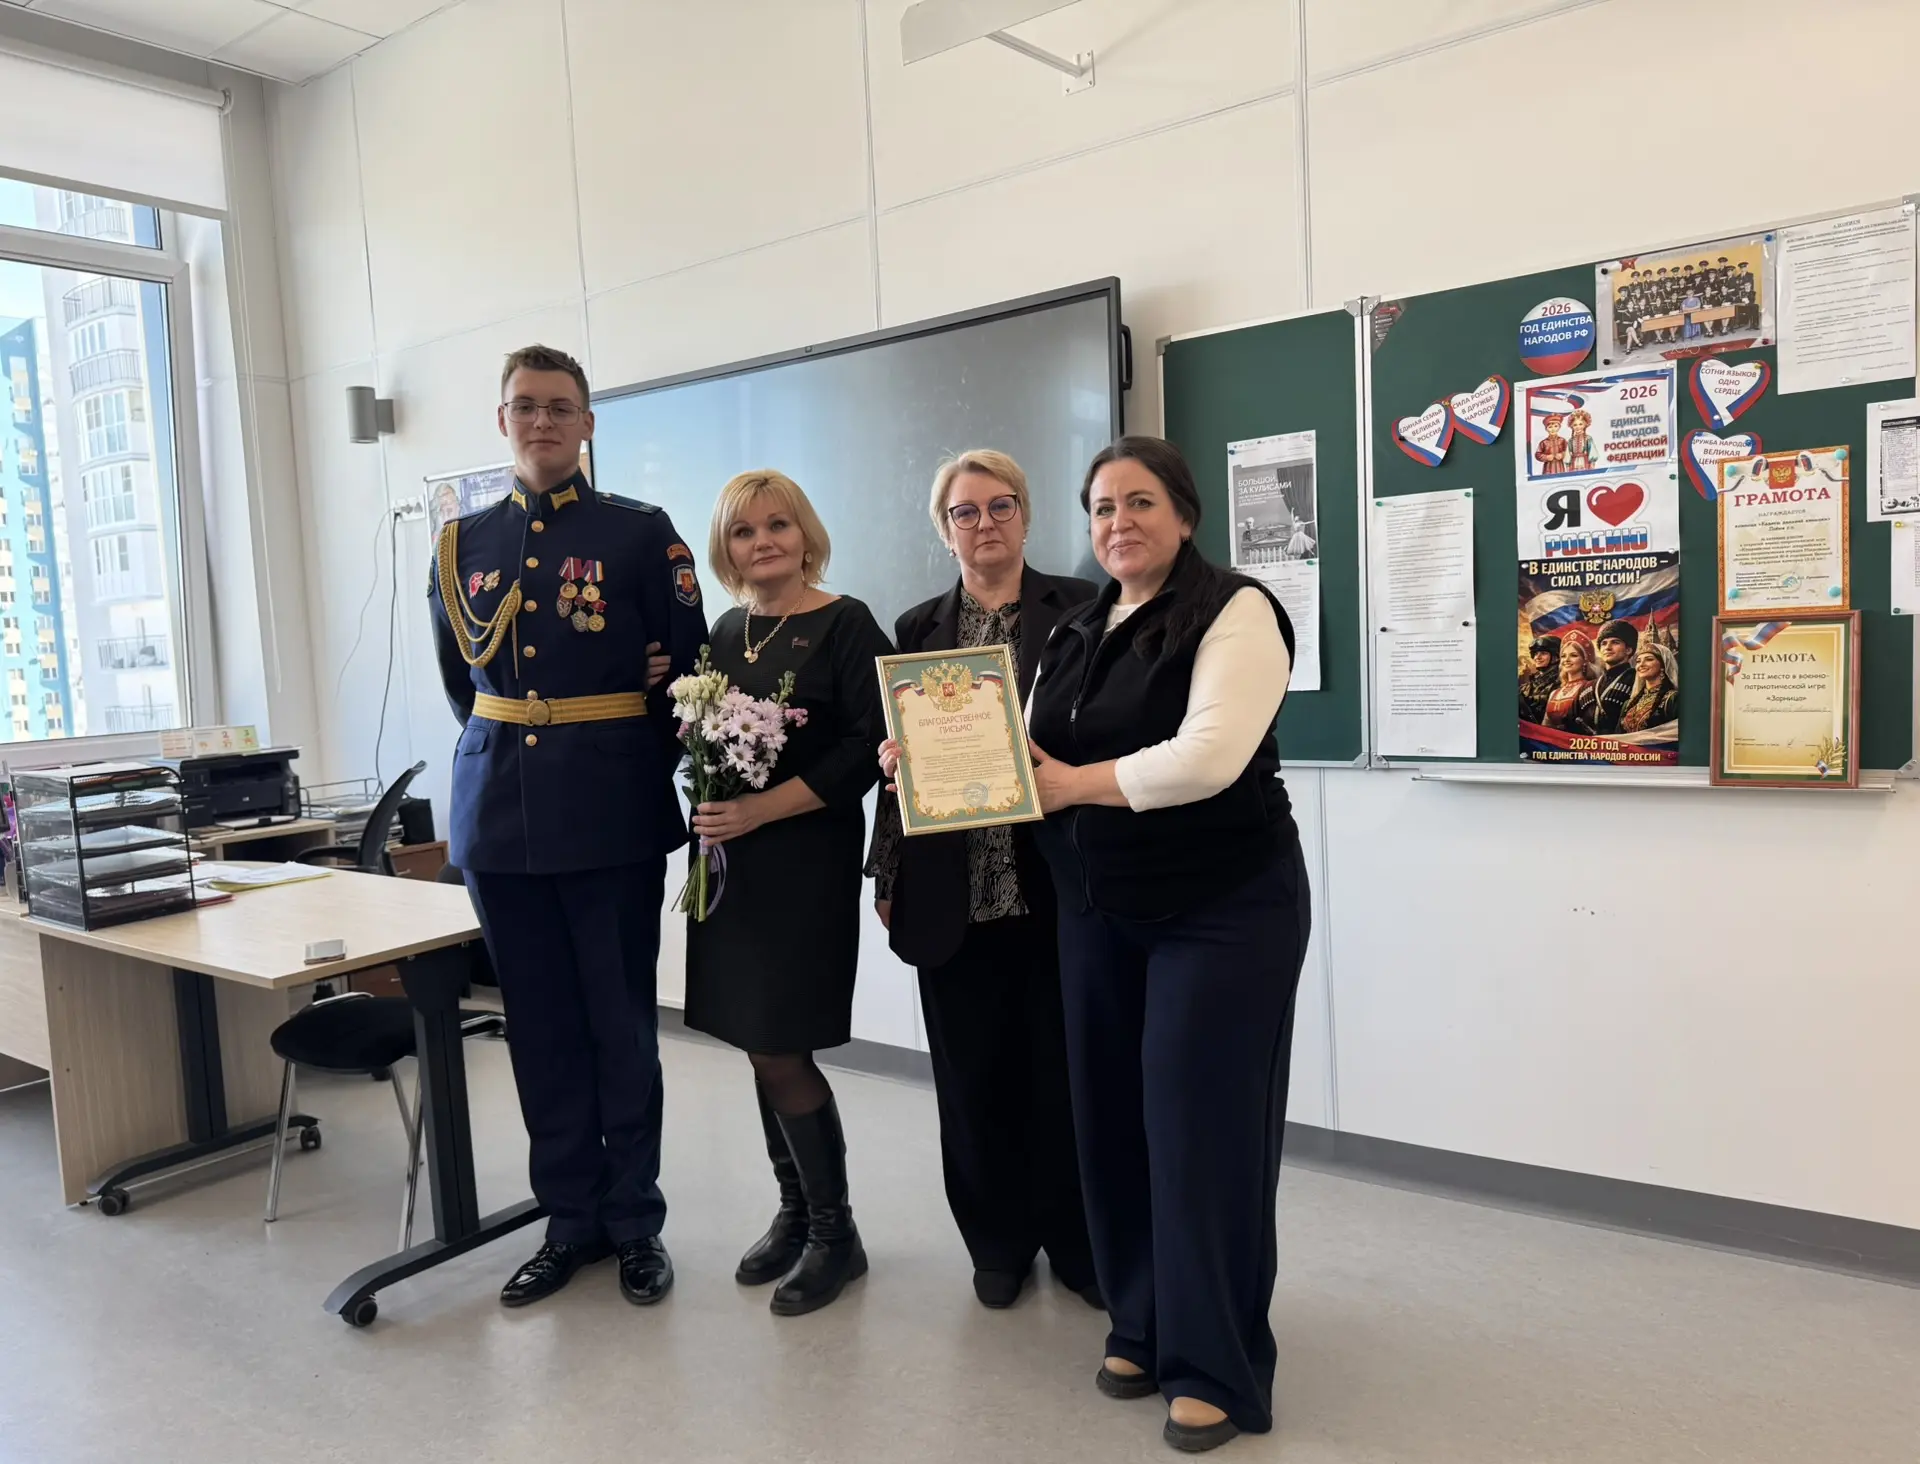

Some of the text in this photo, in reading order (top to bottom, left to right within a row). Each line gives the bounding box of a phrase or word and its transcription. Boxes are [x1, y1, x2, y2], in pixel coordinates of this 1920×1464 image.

[1541, 303, 1571, 317] 2026
[1520, 315, 1593, 334] ГОД ЕДИНСТВА
[1524, 328, 1588, 345] НАРОДОВ РФ
[1701, 367, 1757, 378] СОТНИ ЯЗЫКОВ
[1718, 378, 1741, 387] ОДНО
[1453, 384, 1498, 410] СИЛА РОССИИ
[1620, 384, 1658, 401] 2026
[1713, 387, 1742, 397] СЕРДЦЕ
[1467, 395, 1494, 413] ДРУЖБЕ
[1625, 403, 1646, 415] ГОД
[1464, 403, 1496, 421] НАРОДОВ
[1400, 408, 1442, 434] ЕДИНАЯ СЕМЬЯ
[1411, 419, 1440, 437] ВЕЛИКАЯ
[1610, 414, 1662, 429] ЕДИНСТВА
[1417, 427, 1442, 443] РОССИЯ
[1612, 426, 1660, 440] НАРОДОВ
[1603, 434, 1669, 453] РОССИЙСКОЙ
[1606, 448, 1667, 463] ФЕДЕРАЦИИ
[1703, 448, 1741, 457] ВЕЛИКАЯ
[1249, 481, 1292, 493] КУЛИСАМИ
[1734, 487, 1831, 507] ГРАМОТА
[1544, 489, 1581, 531] Я
[1544, 526, 1648, 558] РОССИЮ
[1529, 561, 1539, 575] В
[1541, 559, 1600, 575] ЕДИНСТВЕ
[1602, 556, 1658, 571] НАРОДОВ
[1550, 574, 1582, 588] СИЛА
[1751, 652, 1816, 664] ГРАМОТА
[1752, 672, 1765, 680] III
[1767, 672, 1790, 680] место
[1798, 671, 1830, 680] военно-
[1744, 682, 1826, 692] патриотической игре
[918, 711, 993, 727] БЛАГОДАРСТВЕННОЕ
[939, 723, 973, 734] ПИСЬМО
[1569, 737, 1598, 751] 2026
[1532, 751, 1661, 761] ГОД ЕДИНСТВА НАРОДОВ РОССИИ
